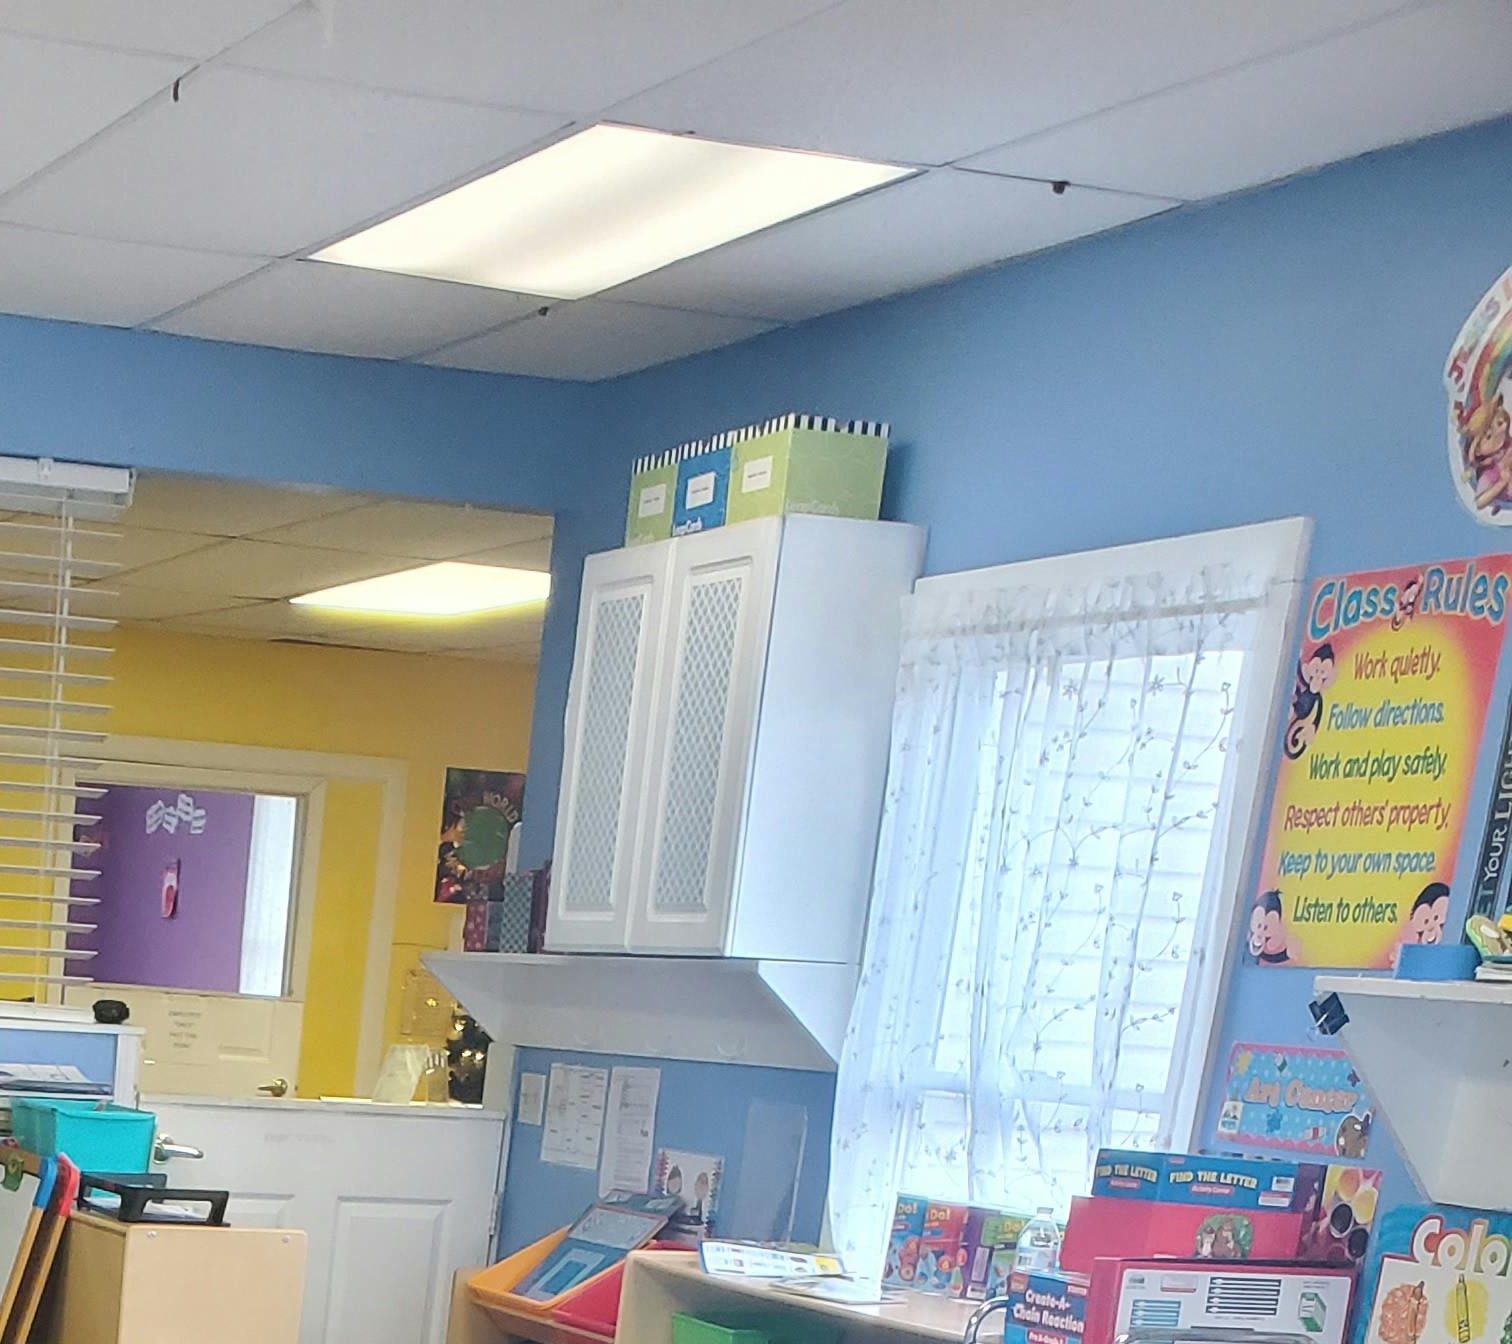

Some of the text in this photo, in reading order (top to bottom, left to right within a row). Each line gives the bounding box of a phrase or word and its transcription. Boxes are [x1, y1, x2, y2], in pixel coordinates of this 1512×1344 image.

[1309, 563, 1509, 642] Class Rules
[1354, 645, 1441, 684] Work quietly.
[1327, 698, 1444, 731] Follow directions.
[1309, 746, 1448, 784] Work and play safely.
[1284, 801, 1340, 834] Respect
[1387, 797, 1452, 832] property.
[1278, 848, 1437, 880] Keep to your own space.
[1482, 828, 1508, 882] YOUR
[1293, 896, 1399, 923] Listen to others.
[1113, 1163, 1130, 1177] THE
[1130, 1164, 1158, 1183] LETTER
[1169, 1170, 1258, 1189] FIND THE LETTER
[929, 1207, 951, 1221] Do!
[1013, 1303, 1085, 1334] Chain Reaction
